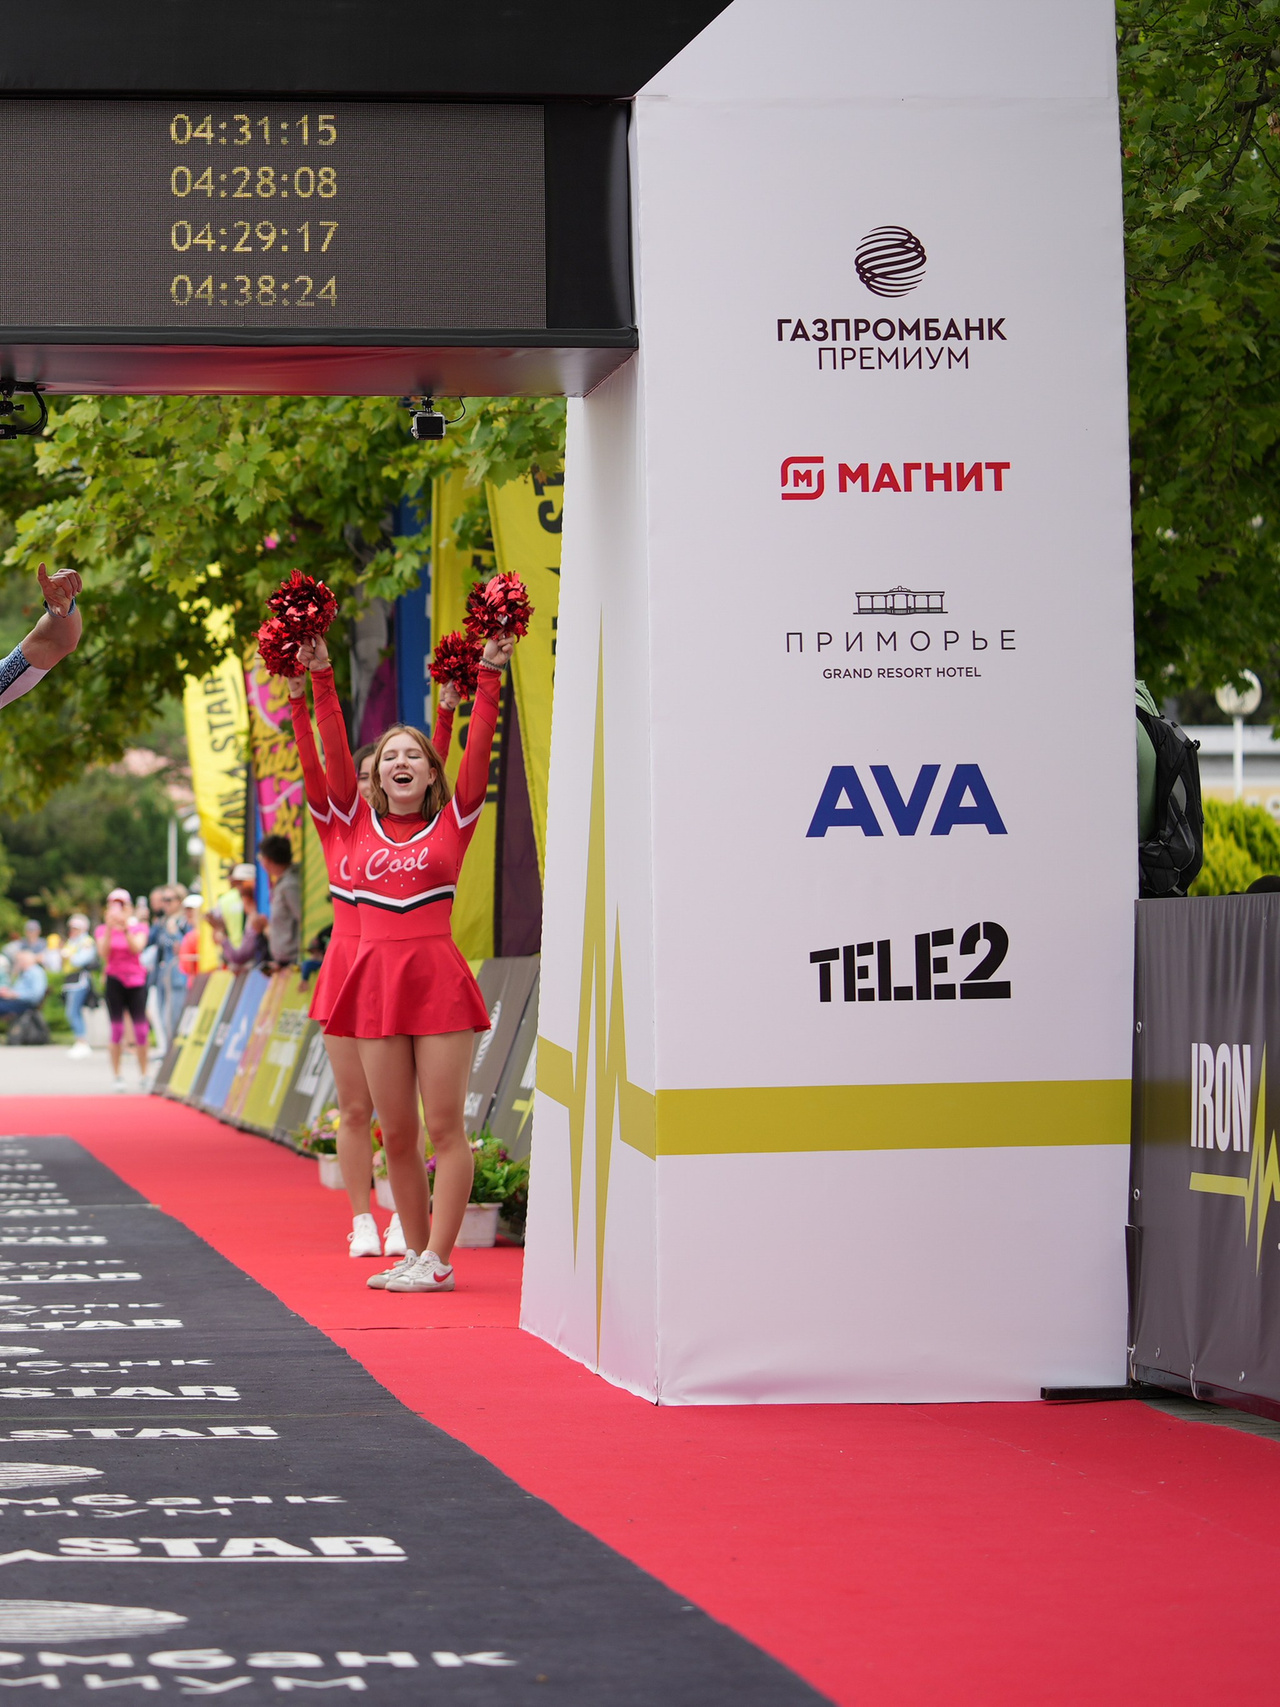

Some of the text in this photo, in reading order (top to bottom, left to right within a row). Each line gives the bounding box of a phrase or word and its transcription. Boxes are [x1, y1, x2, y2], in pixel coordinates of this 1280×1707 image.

[170, 114, 338, 145] 04:31:15
[170, 166, 338, 198] 04:28:08
[170, 220, 339, 252] 04:29:17
[170, 274, 338, 306] 04:38:24
[777, 317, 1008, 342] ГАЗПРОМБАНК
[818, 346, 969, 370] ПРЕМИУМ
[838, 462, 1011, 493] МАГНИТ
[786, 630, 1017, 653] ПРИМОРЬЕ
[822, 667, 982, 679] GRAND RESORT HOTEL
[806, 764, 1008, 838] AVA
[365, 847, 429, 881] Cool
[809, 921, 1012, 1003] TELE2
[1191, 1042, 1251, 1153] IRON
[9, 1425, 279, 1439] STAR
[57, 1535, 406, 1556] STAR
